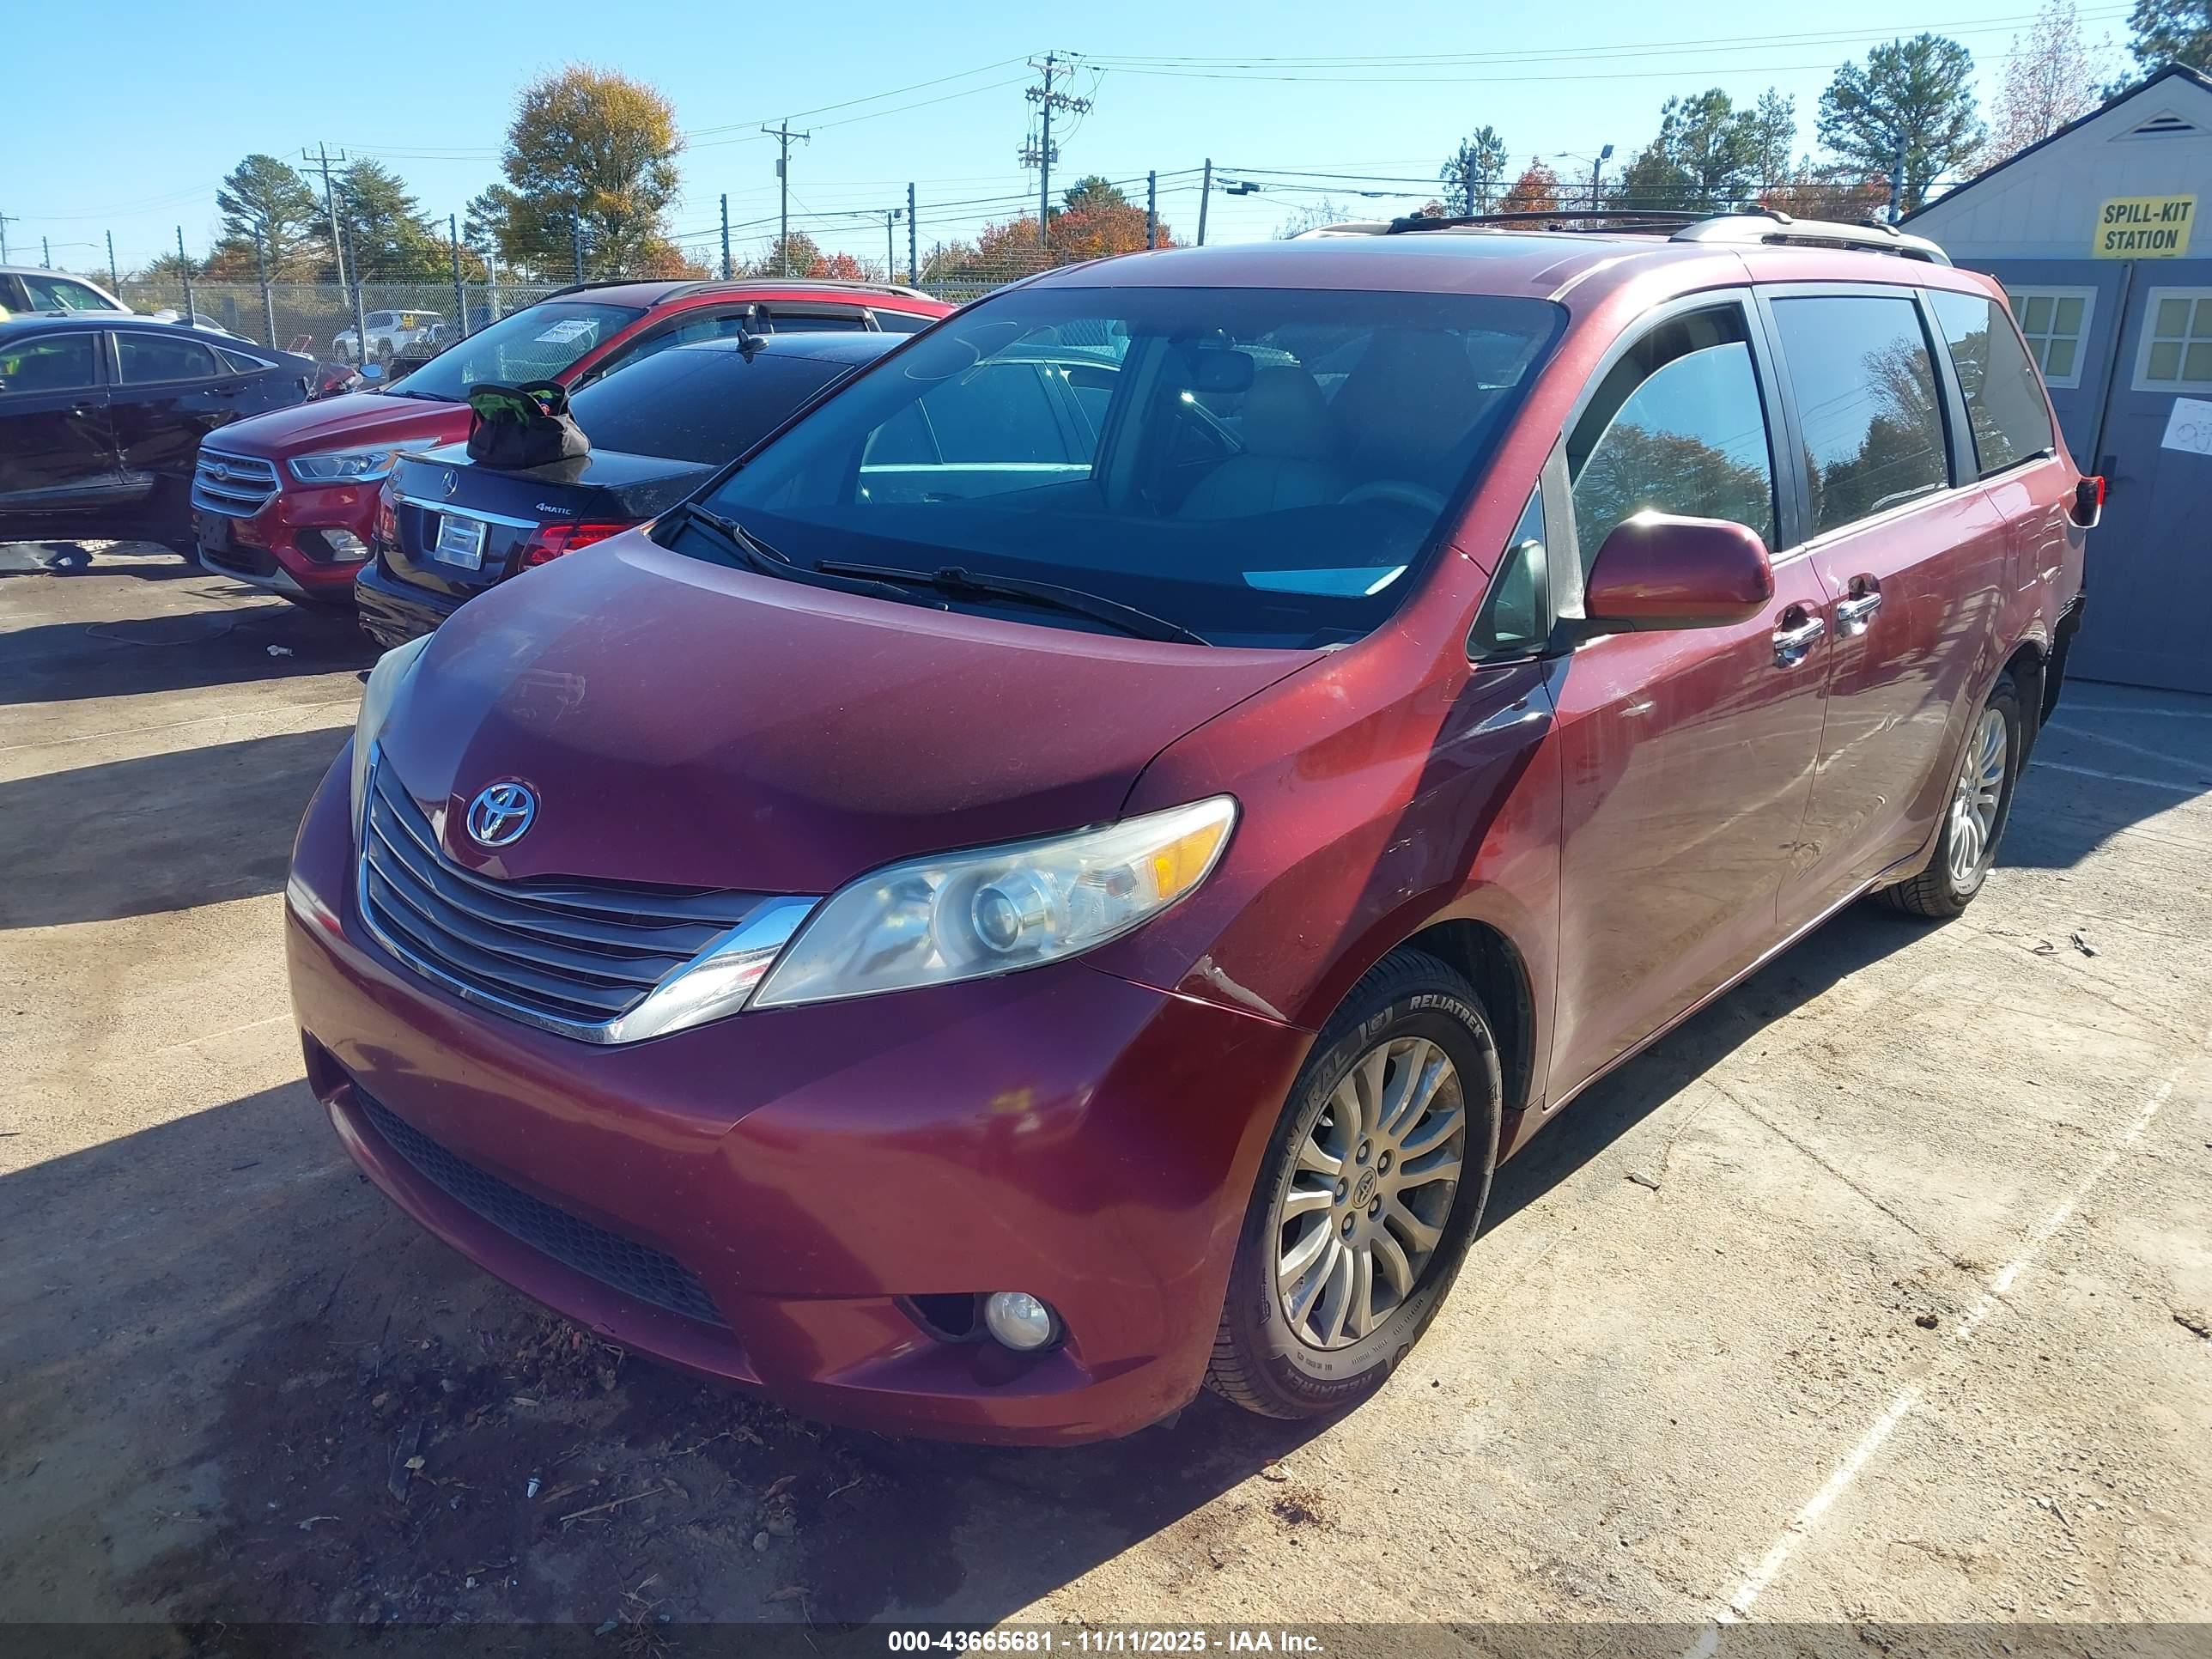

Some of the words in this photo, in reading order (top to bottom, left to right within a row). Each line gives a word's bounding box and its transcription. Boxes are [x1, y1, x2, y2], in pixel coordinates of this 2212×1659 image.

[2104, 201, 2192, 224] SPILL-KIT
[2105, 228, 2179, 250] STATION
[535, 502, 571, 515] 4MATIC
[1409, 994, 1484, 1038] RELIATREK
